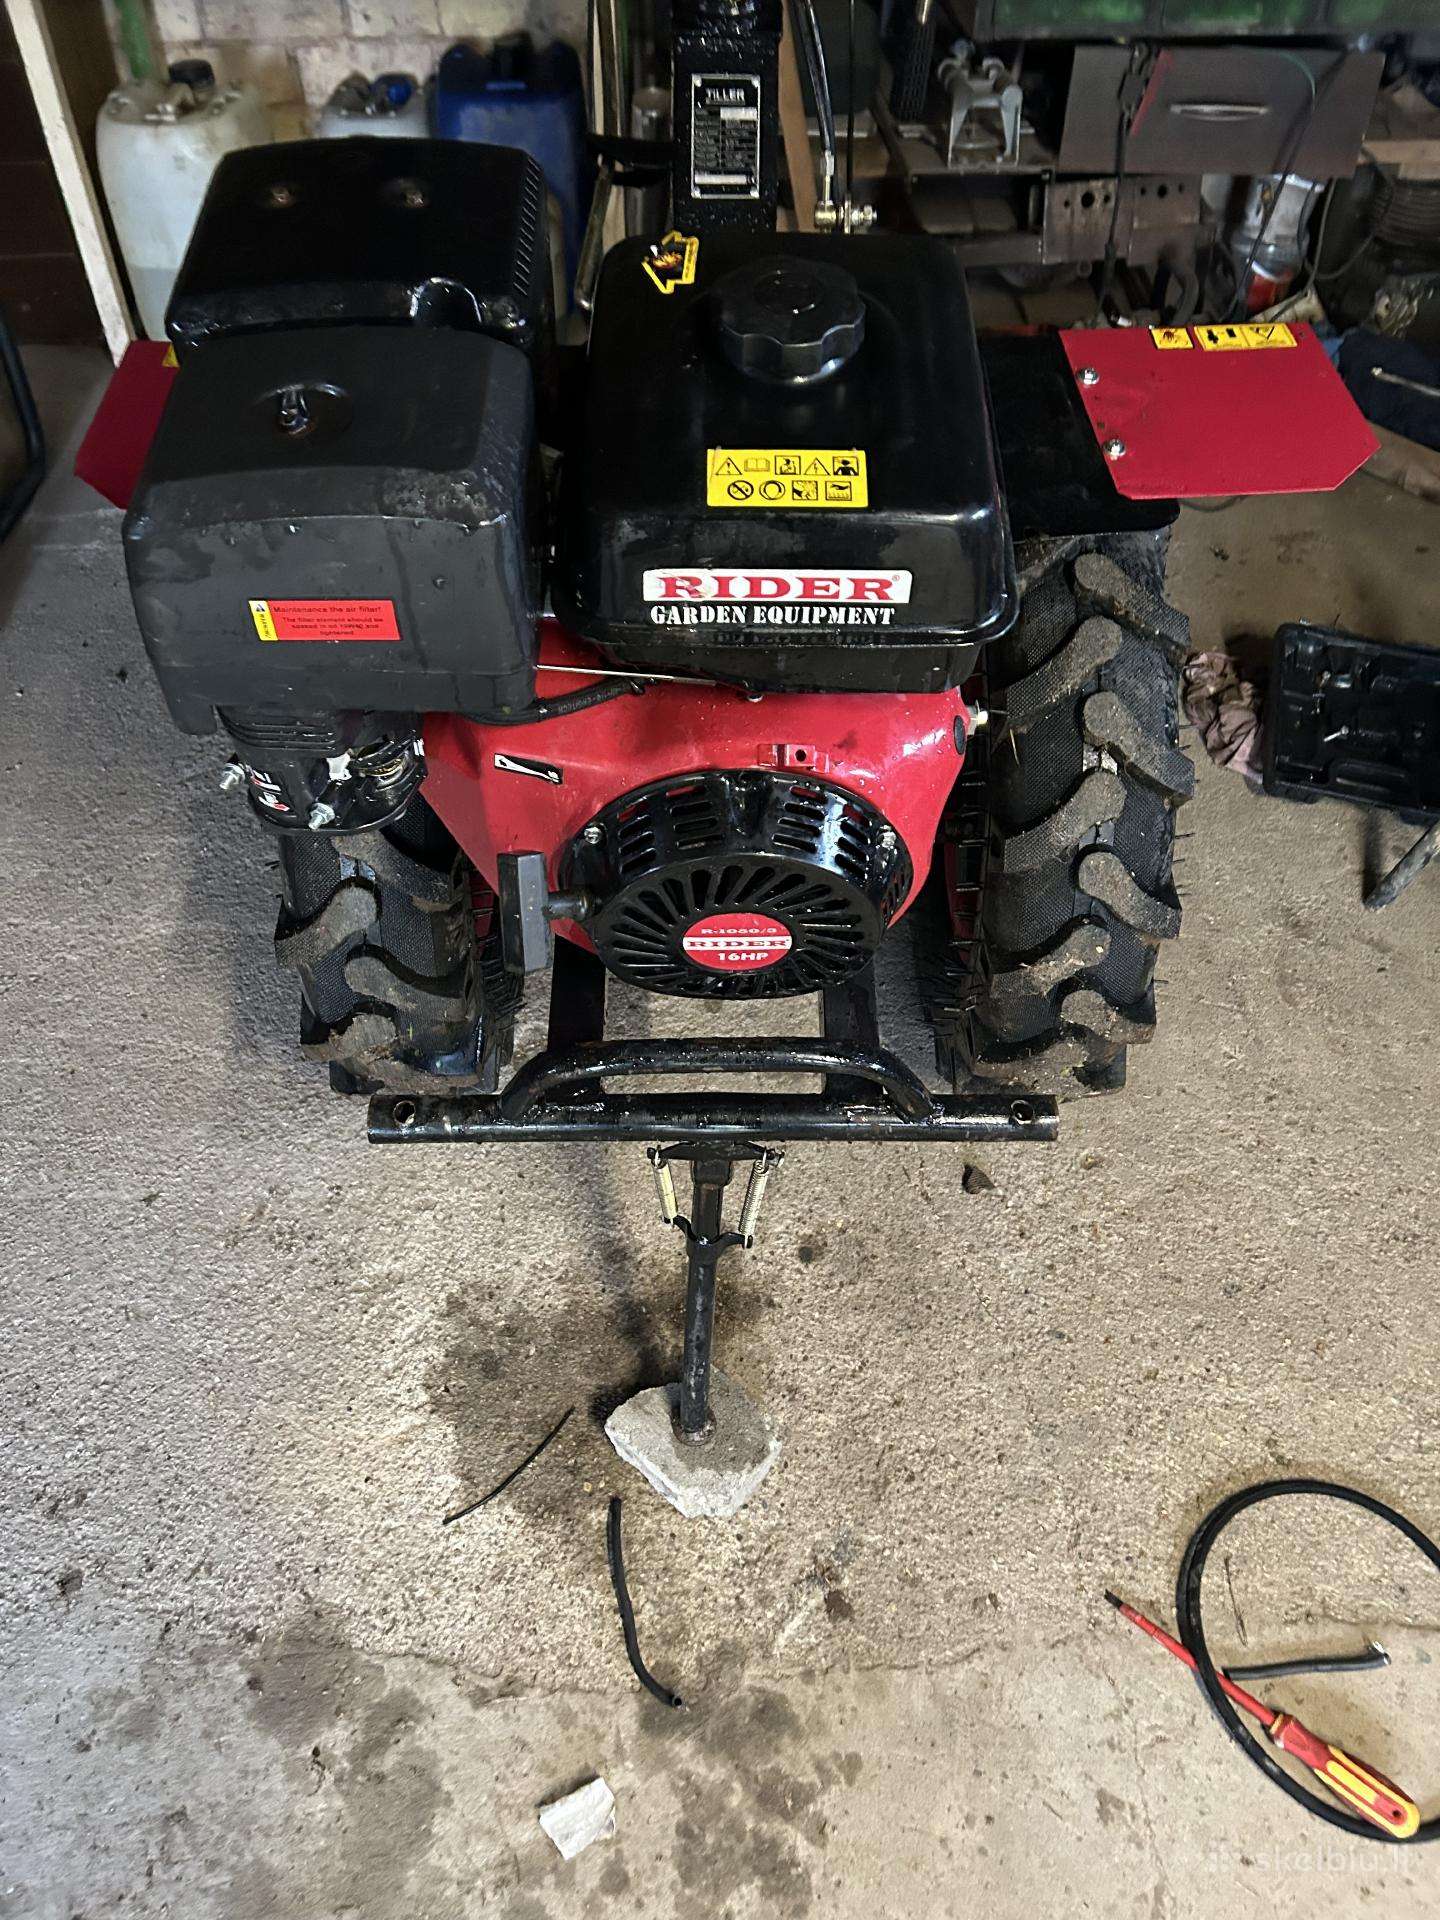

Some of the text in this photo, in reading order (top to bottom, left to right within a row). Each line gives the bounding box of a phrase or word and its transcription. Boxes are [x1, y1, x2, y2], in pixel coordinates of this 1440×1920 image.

[705, 88, 745, 101] TILLER
[656, 576, 894, 600] RIDER
[650, 605, 895, 625] GARDEN EQUIPMENT
[718, 952, 769, 961] 16HP
